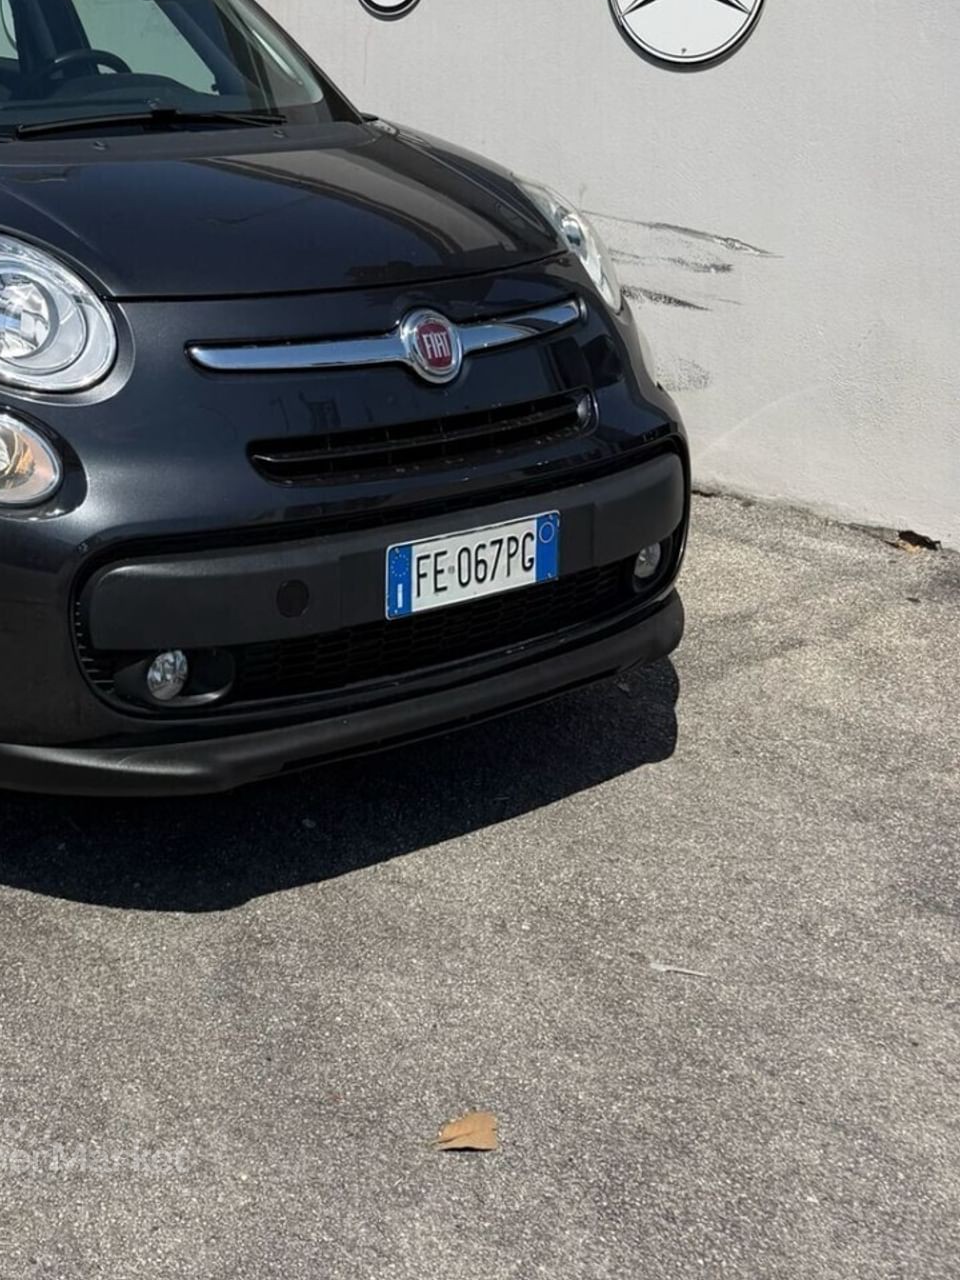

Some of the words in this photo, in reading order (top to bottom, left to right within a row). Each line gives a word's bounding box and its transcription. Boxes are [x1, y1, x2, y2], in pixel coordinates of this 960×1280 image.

[421, 331, 451, 359] FIAT
[416, 550, 448, 599] FE
[457, 531, 535, 588] 067PG
